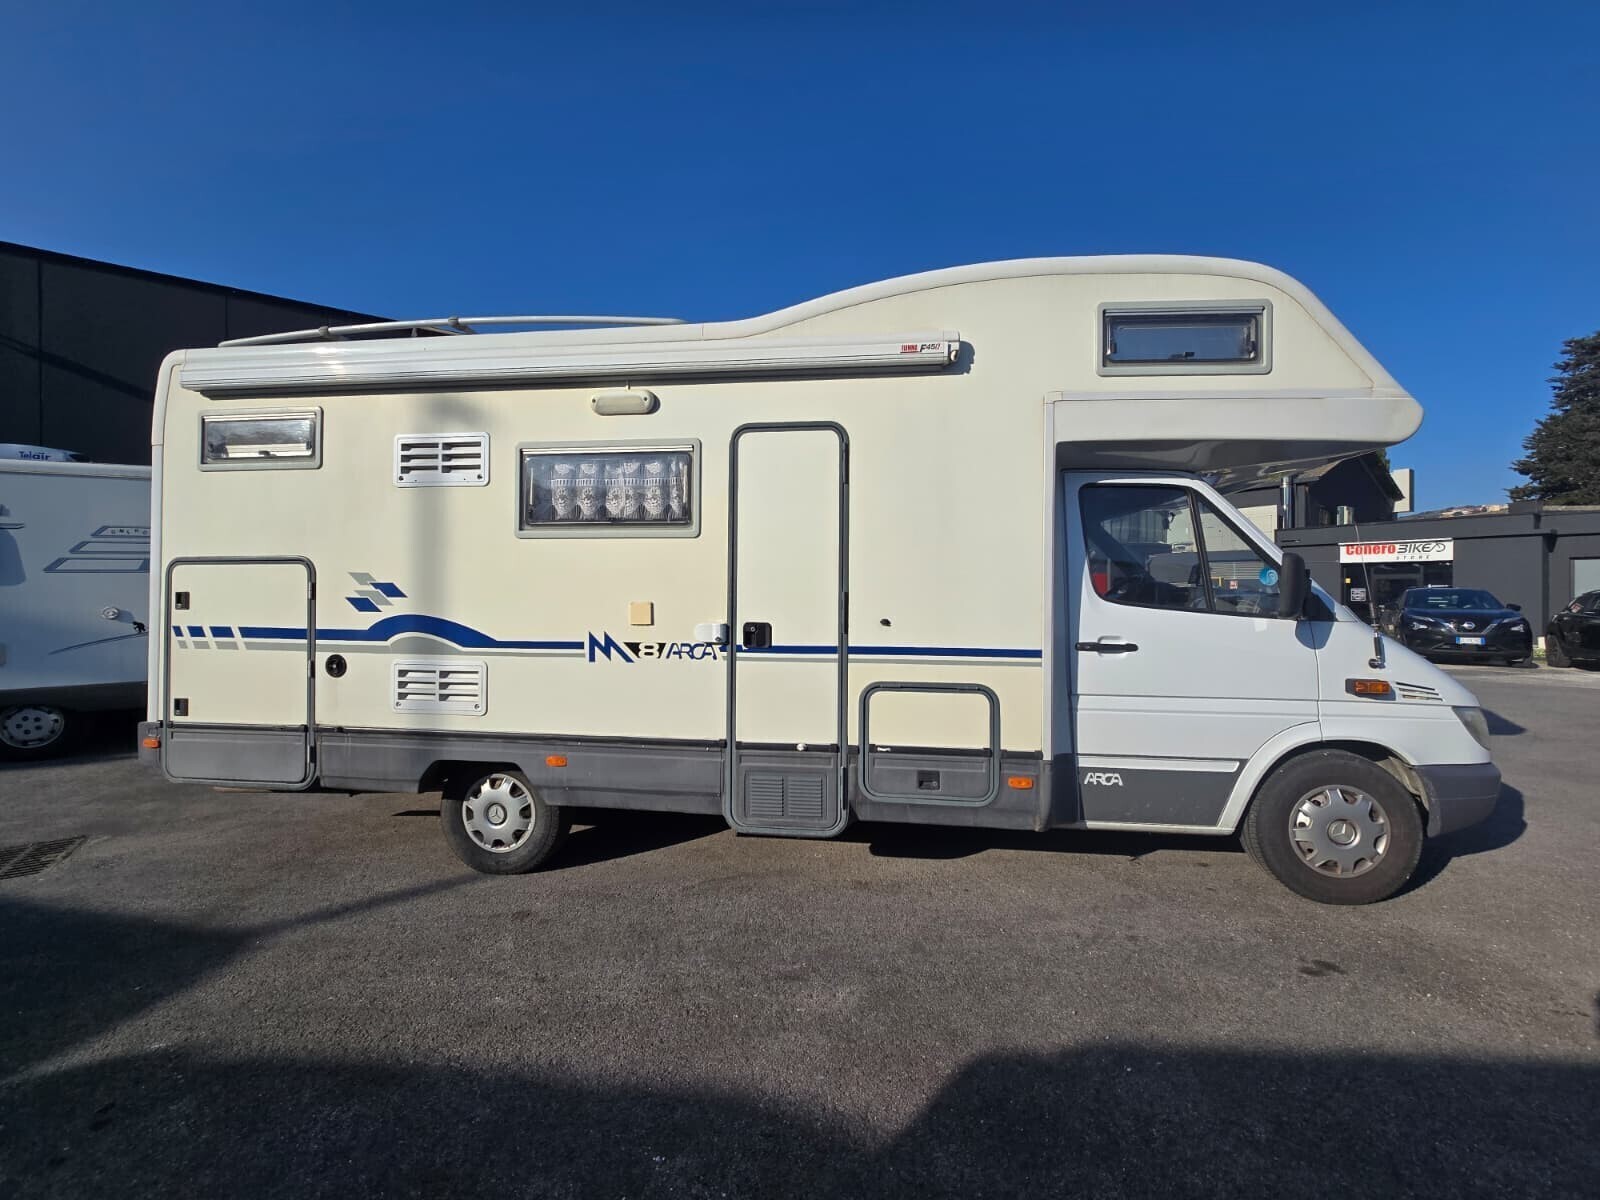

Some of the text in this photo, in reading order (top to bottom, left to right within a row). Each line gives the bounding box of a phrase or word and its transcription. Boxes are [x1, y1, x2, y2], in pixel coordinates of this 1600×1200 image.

[18, 450, 51, 461] Telair
[1345, 543, 1431, 555] Conero BIKE
[666, 642, 717, 660] ARCA
[1084, 772, 1123, 786] ARCA
